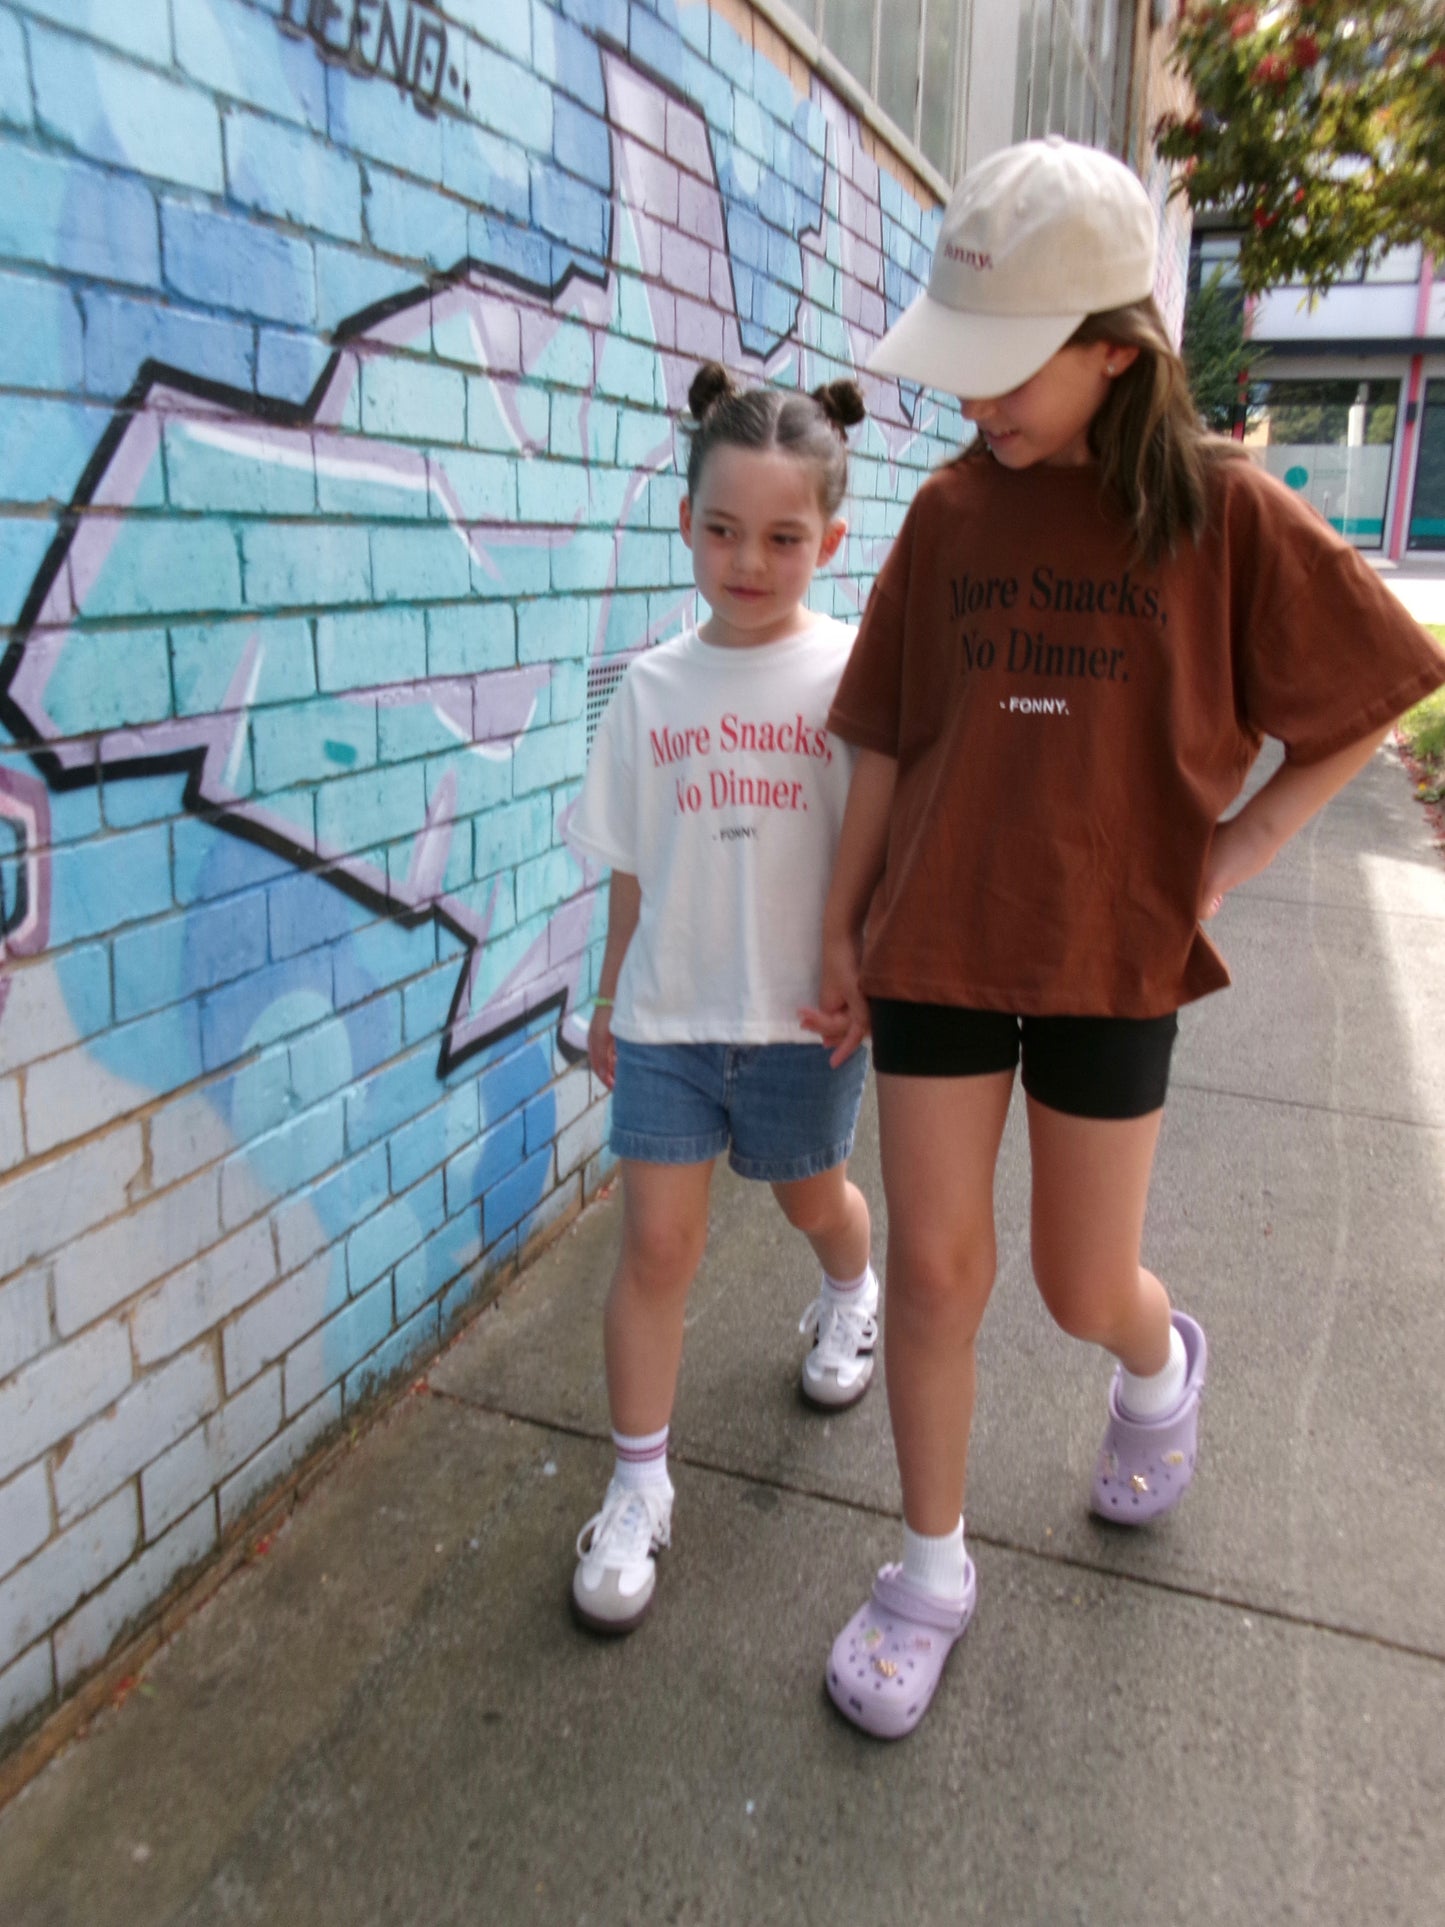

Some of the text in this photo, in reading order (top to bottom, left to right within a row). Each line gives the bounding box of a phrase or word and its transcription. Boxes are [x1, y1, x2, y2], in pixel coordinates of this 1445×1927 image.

[1030, 566, 1168, 626] Snacks,
[1008, 629, 1130, 683] Dinner.
[650, 712, 833, 768] More Snacks,
[711, 769, 808, 812] Dinner.
